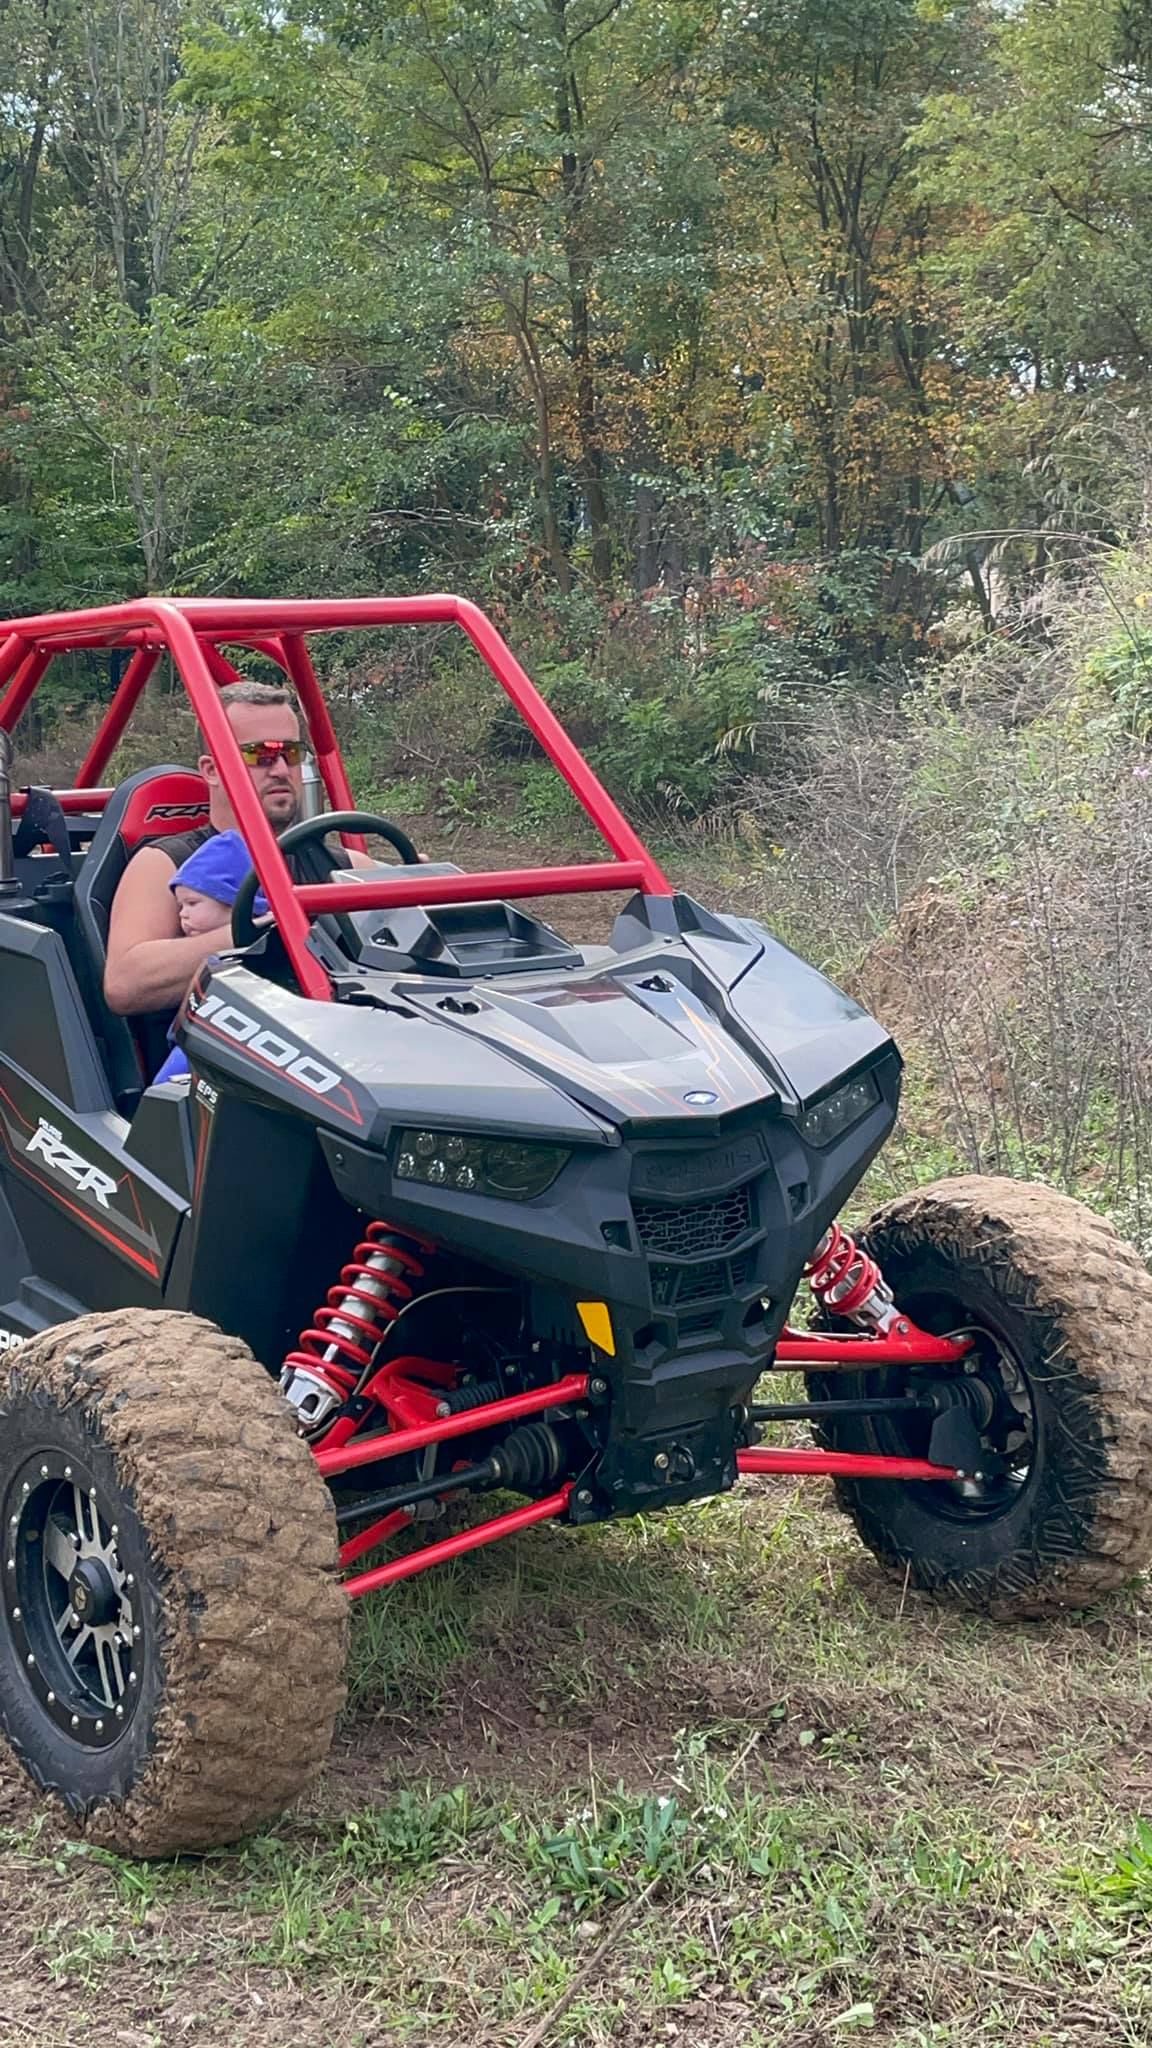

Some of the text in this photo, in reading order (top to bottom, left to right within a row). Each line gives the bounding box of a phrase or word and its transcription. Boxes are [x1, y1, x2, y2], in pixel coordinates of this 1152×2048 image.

[196, 995, 342, 1094] 1000
[197, 1079, 218, 1104] EPS
[26, 1126, 118, 1208] RZR
